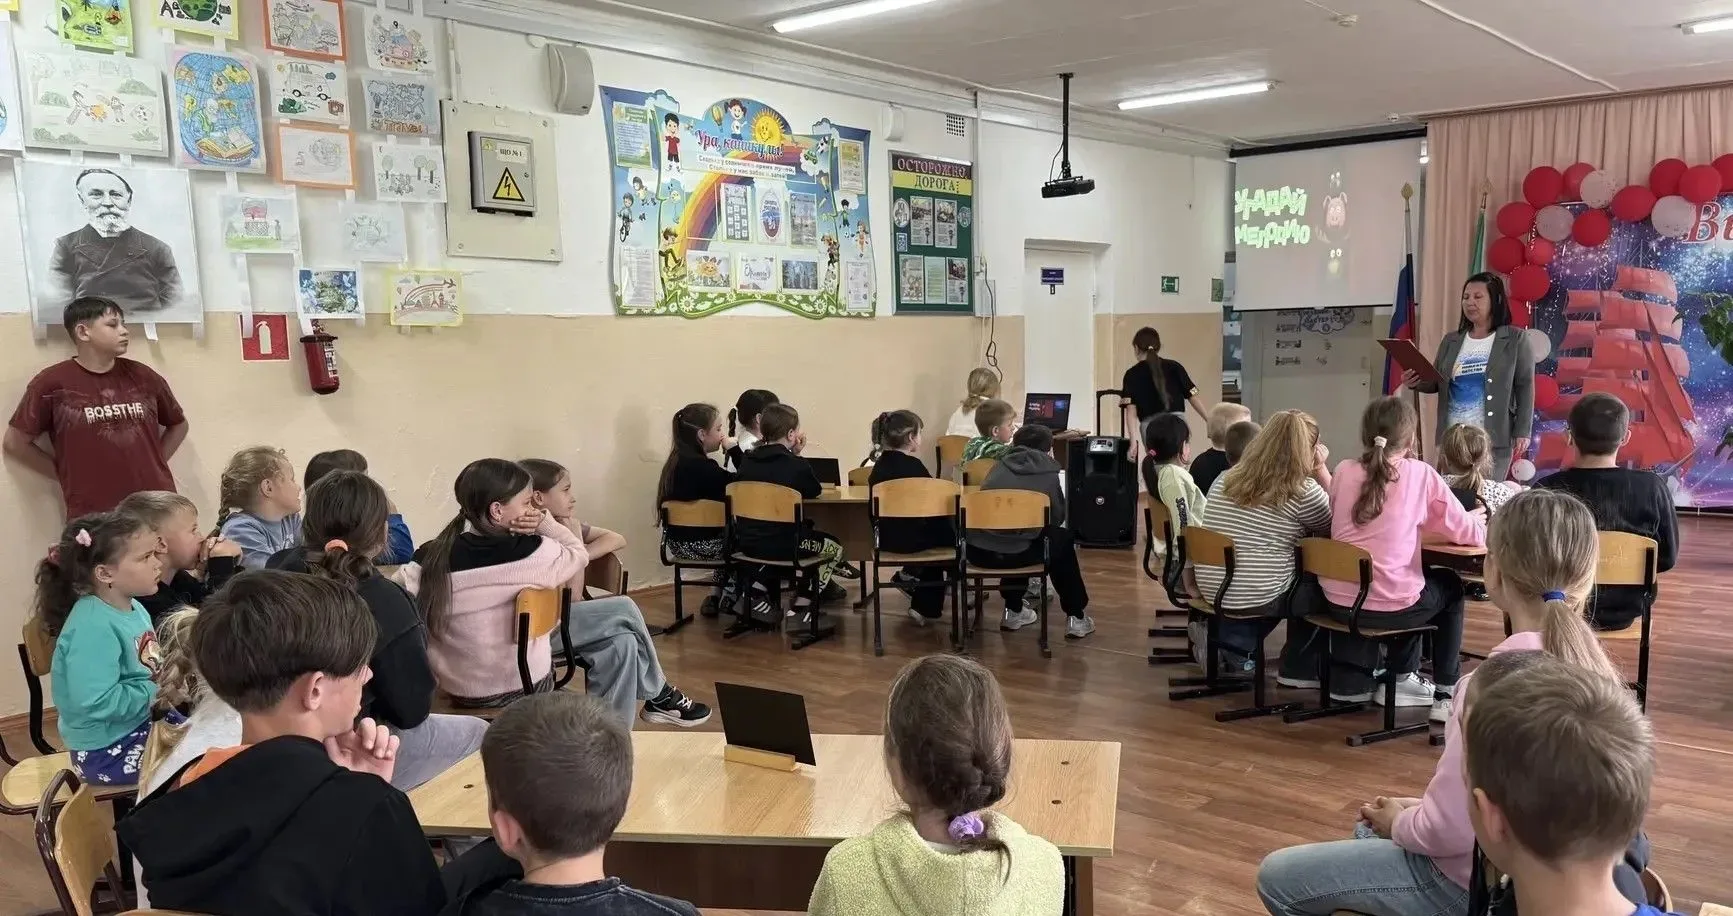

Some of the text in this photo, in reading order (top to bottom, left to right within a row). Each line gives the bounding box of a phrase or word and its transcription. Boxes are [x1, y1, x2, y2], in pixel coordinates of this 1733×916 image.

[694, 129, 784, 157] Ура, каникулы!
[84, 402, 144, 422] BOSSTHE
